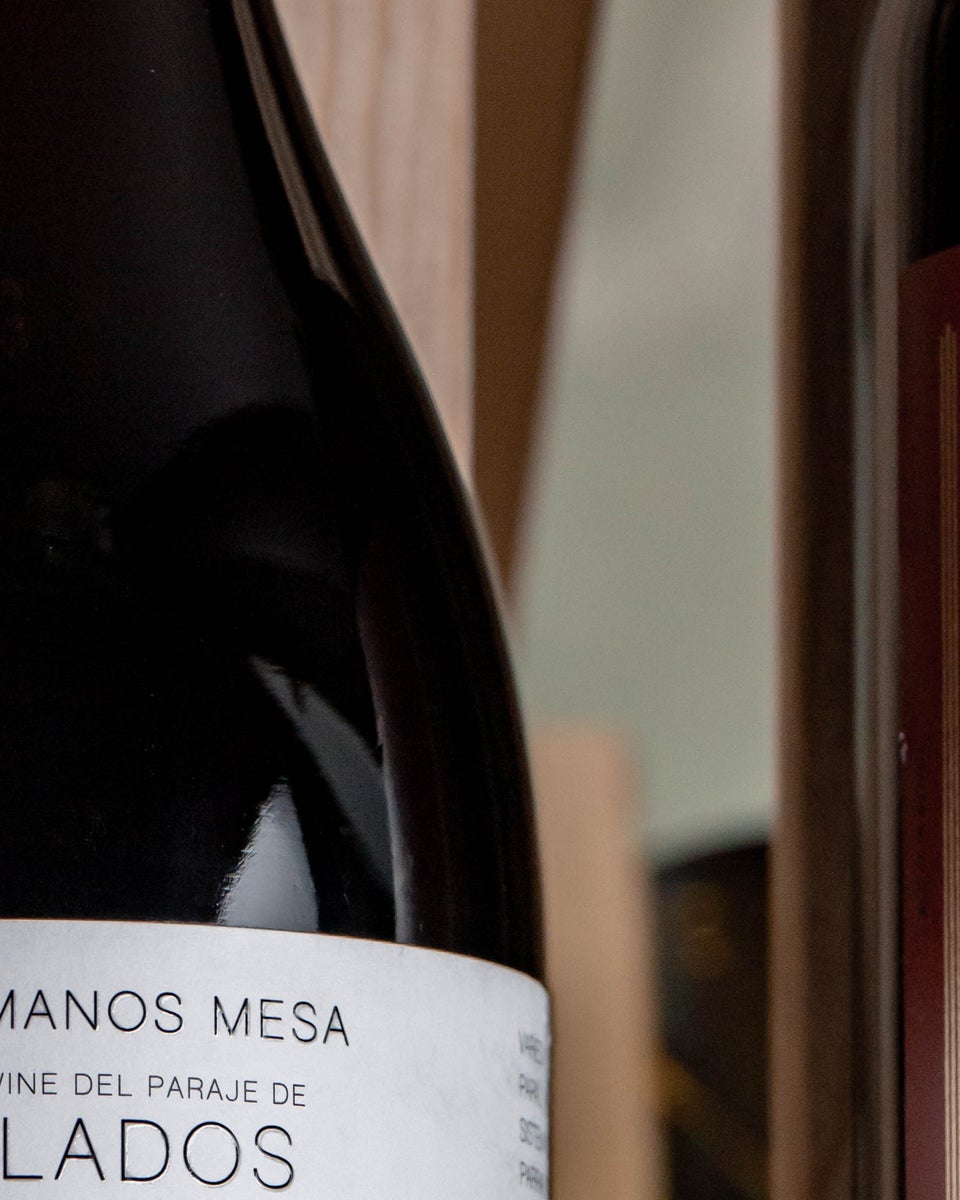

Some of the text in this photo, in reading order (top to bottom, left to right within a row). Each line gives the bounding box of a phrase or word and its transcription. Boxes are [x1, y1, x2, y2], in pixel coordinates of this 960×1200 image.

[213, 994, 350, 1048] MESA
[74, 1072, 133, 1097] DEL
[148, 1074, 259, 1104] PARAJE
[272, 1081, 307, 1108] DE
